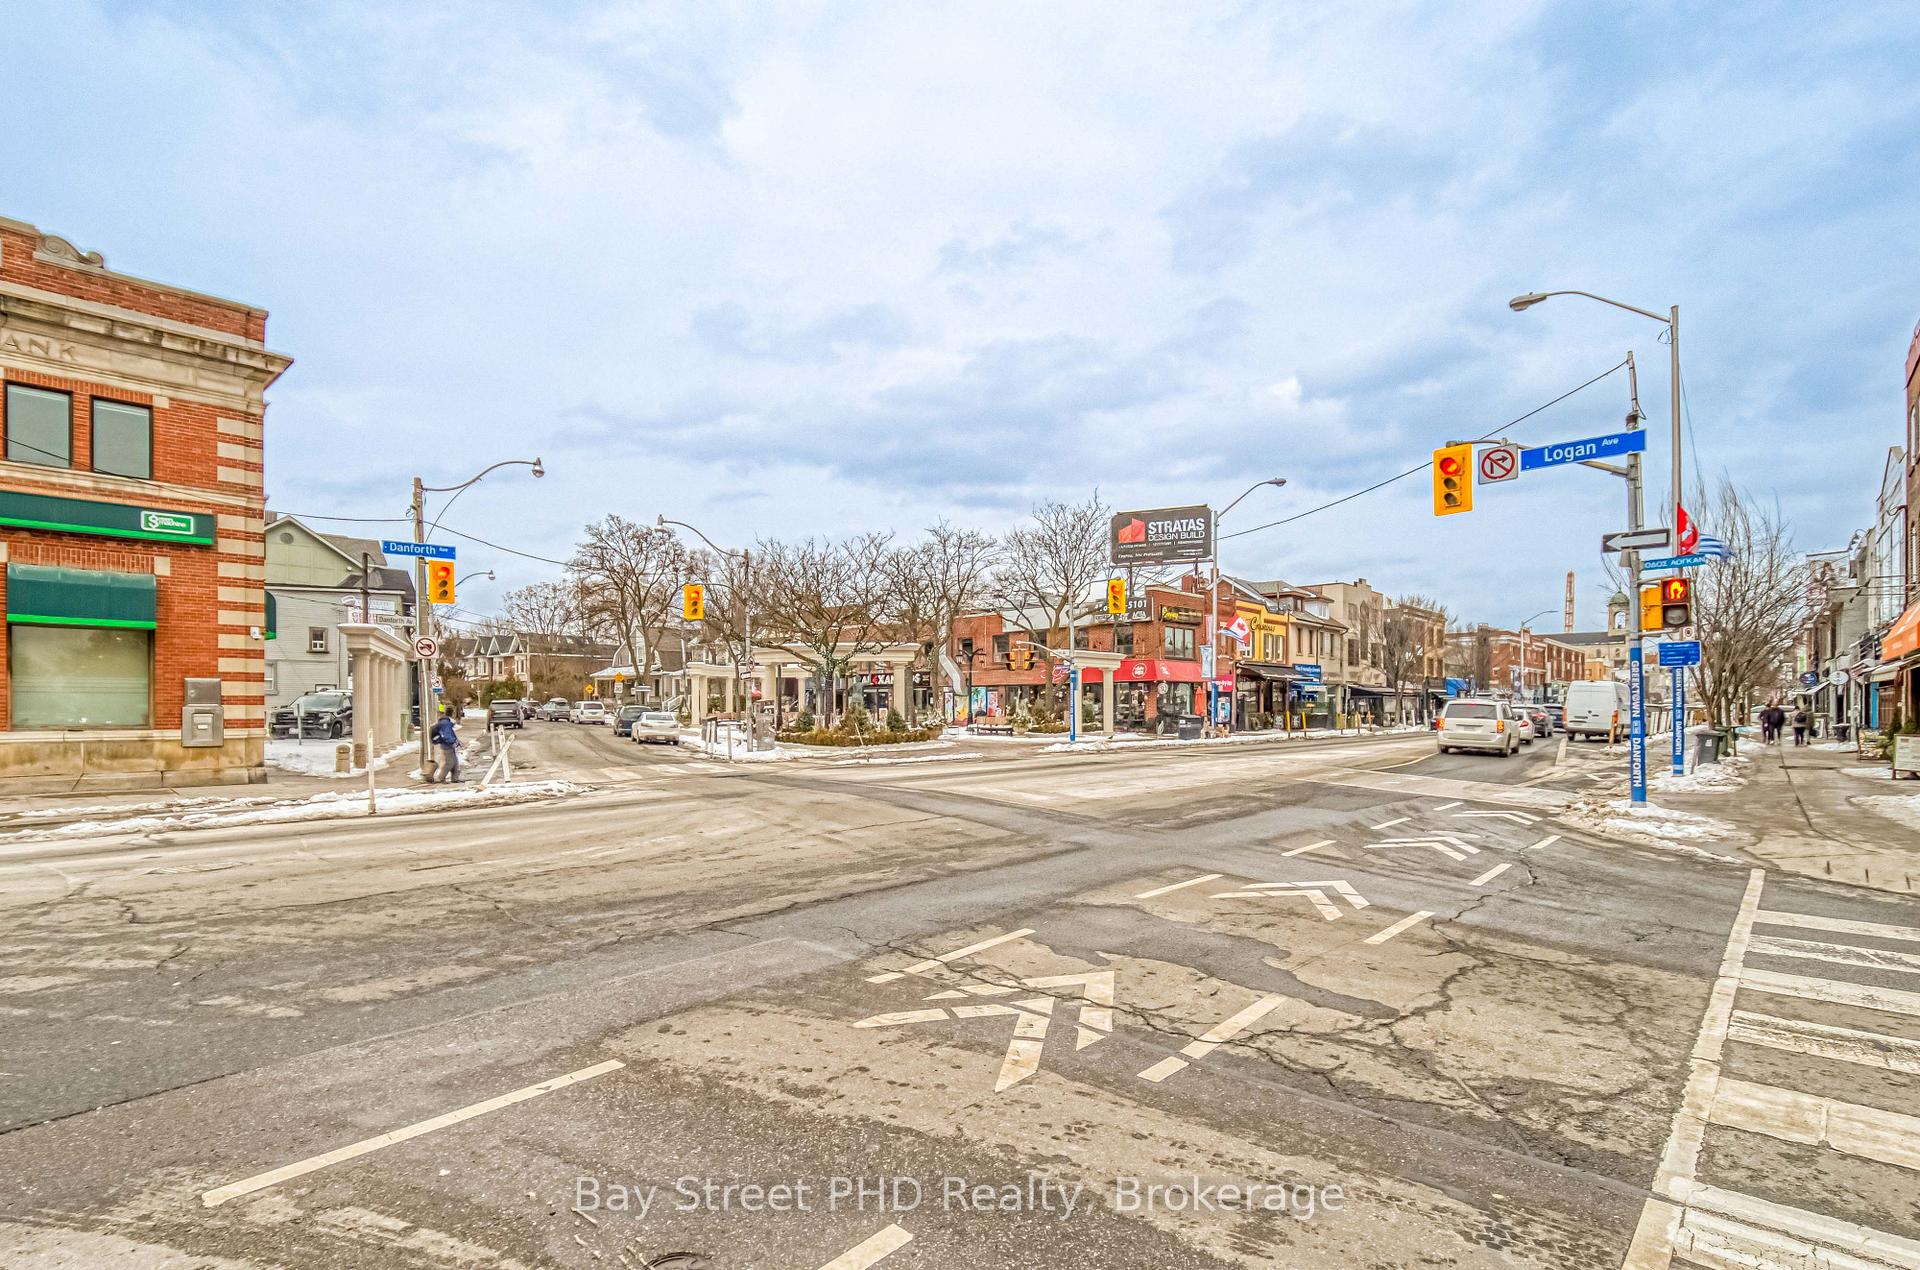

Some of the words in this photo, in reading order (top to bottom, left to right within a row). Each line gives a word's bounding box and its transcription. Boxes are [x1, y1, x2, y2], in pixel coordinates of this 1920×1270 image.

[1544, 443, 1596, 462] Logan
[1601, 437, 1619, 447] Ave
[1148, 517, 1205, 535] STRATAS
[1148, 533, 1178, 542] DESIGN
[1180, 530, 1205, 540] BUILD
[389, 542, 436, 555] Danforth
[379, 615, 404, 624] Danforth
[1631, 660, 1641, 718] GREEKTOWN
[1632, 737, 1642, 787] DANFORTH
